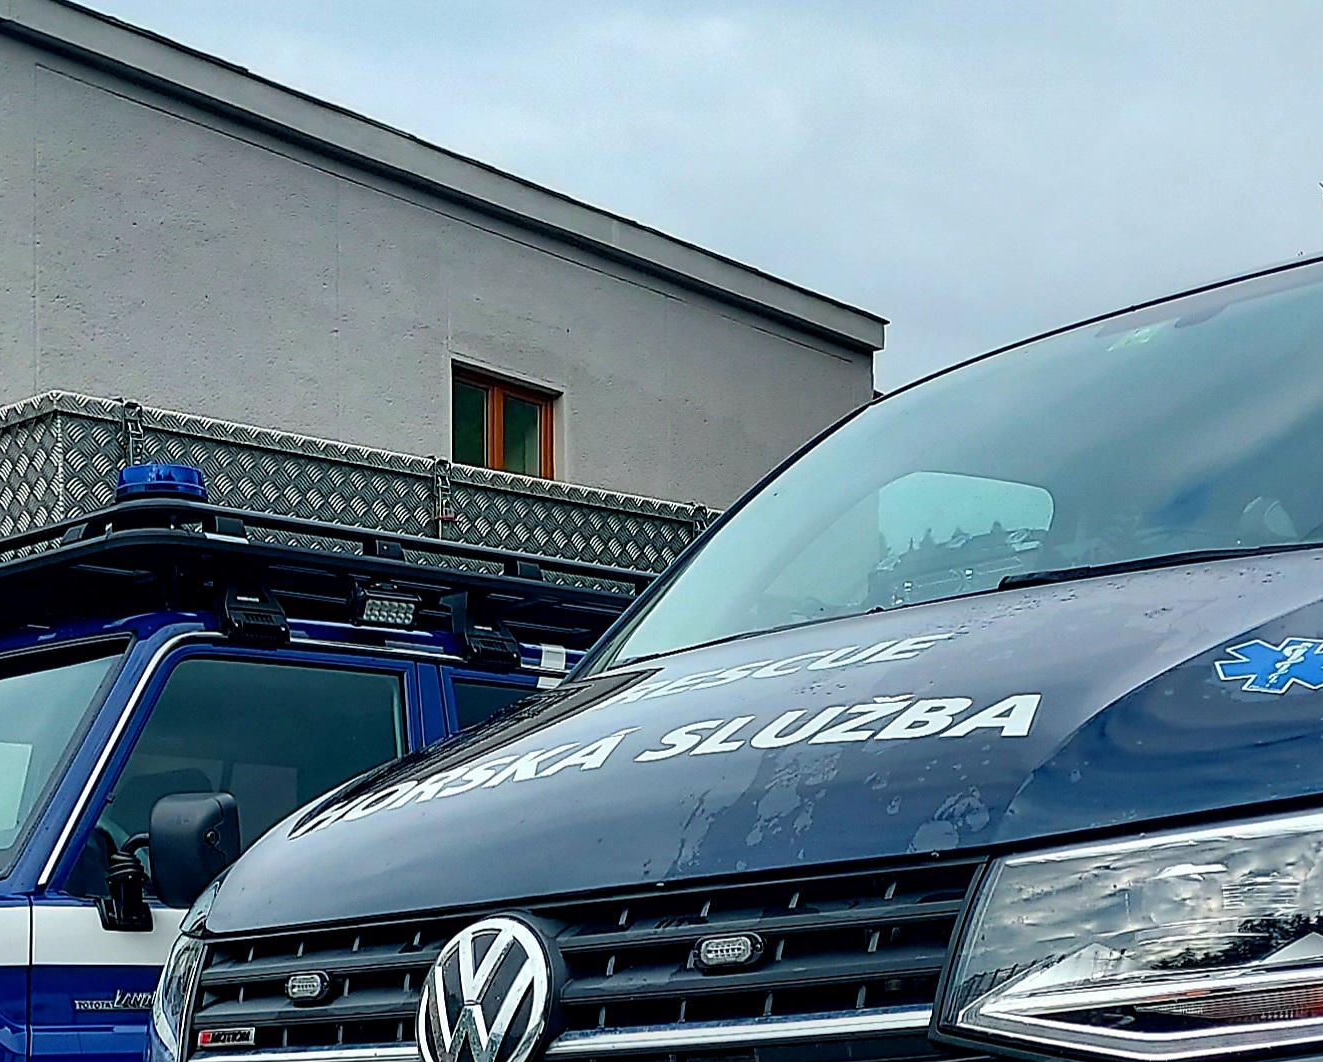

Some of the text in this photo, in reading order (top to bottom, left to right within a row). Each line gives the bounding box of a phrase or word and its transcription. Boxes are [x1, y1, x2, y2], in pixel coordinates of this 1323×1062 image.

[589, 633, 956, 710] RESCUE
[287, 693, 1042, 841] HORSKÁ SLUŽBA
[74, 1000, 115, 1010] TOYOTA
